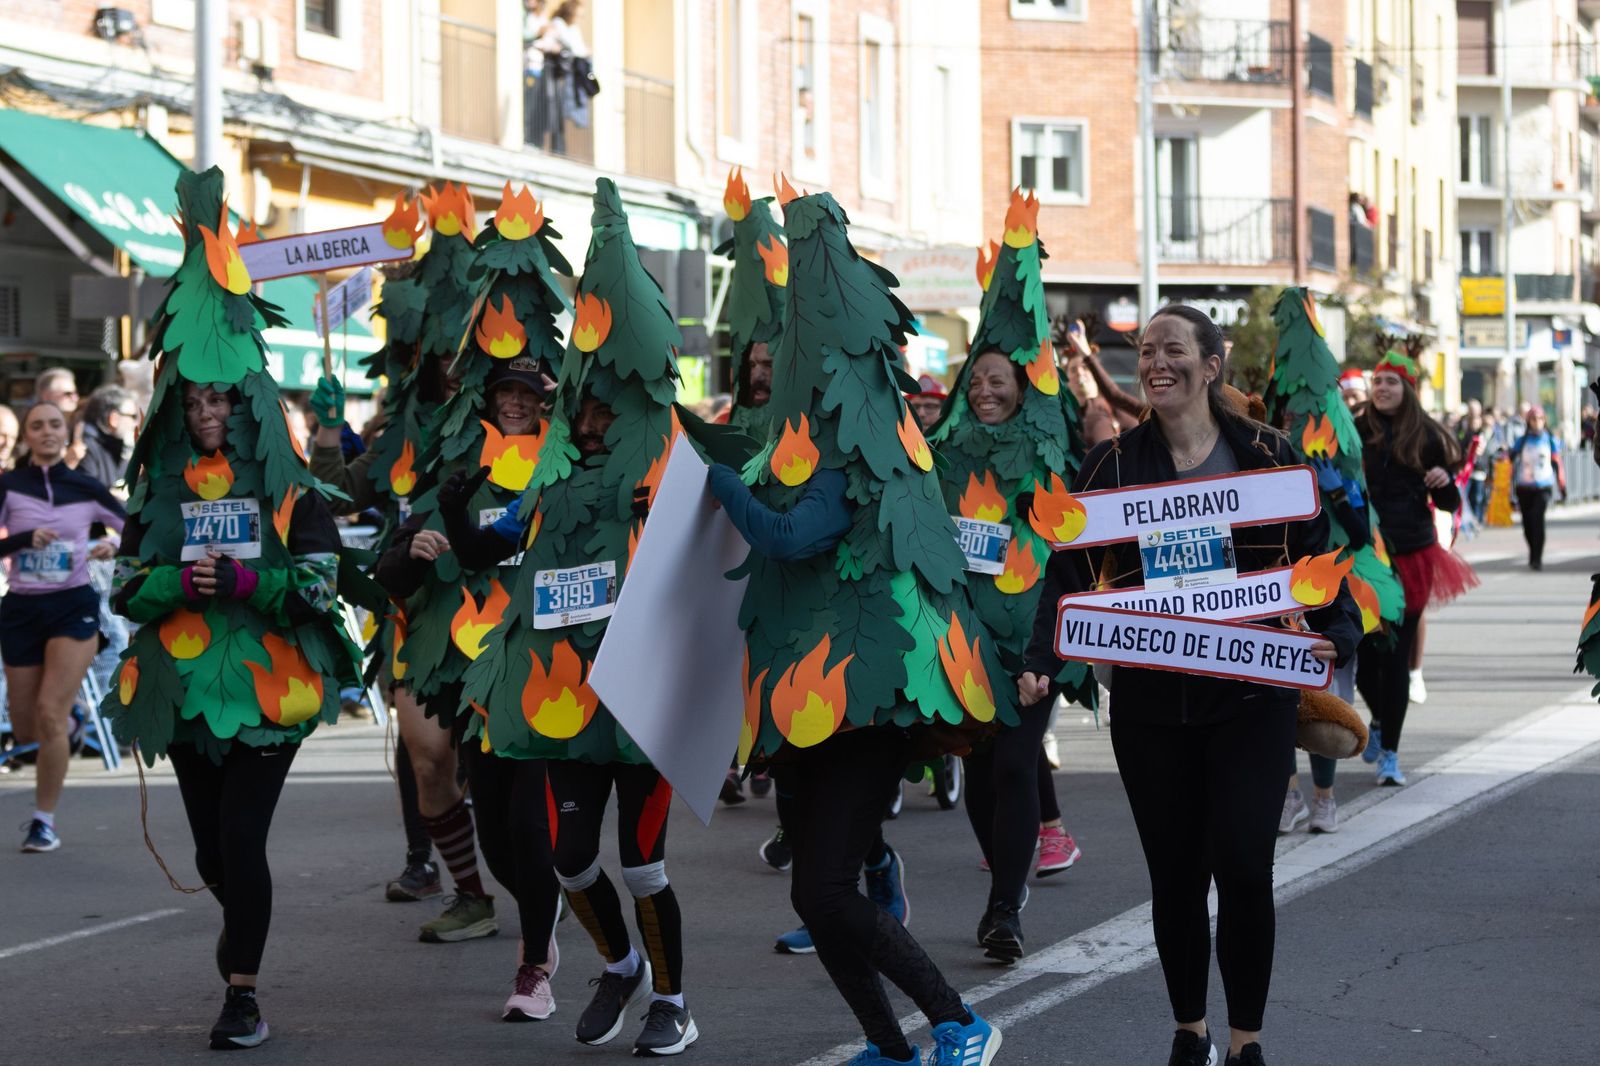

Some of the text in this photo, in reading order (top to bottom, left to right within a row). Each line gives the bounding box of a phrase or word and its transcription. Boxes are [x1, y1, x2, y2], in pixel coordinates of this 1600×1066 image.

[284, 236, 371, 266] LA ALBERCA
[202, 502, 251, 513] SETEL
[1122, 488, 1240, 526] PELABRAVO
[191, 515, 240, 540] 4470
[959, 520, 1003, 536] SETEL
[1163, 525, 1222, 542] SETEL
[24, 552, 61, 570] 4762
[1154, 540, 1213, 572] 4480
[556, 567, 608, 582] SETEL
[549, 580, 595, 610] 3199
[1192, 582, 1282, 614] RODRIGO
[1065, 619, 1326, 675] VILLASECO DE LOS REYES
